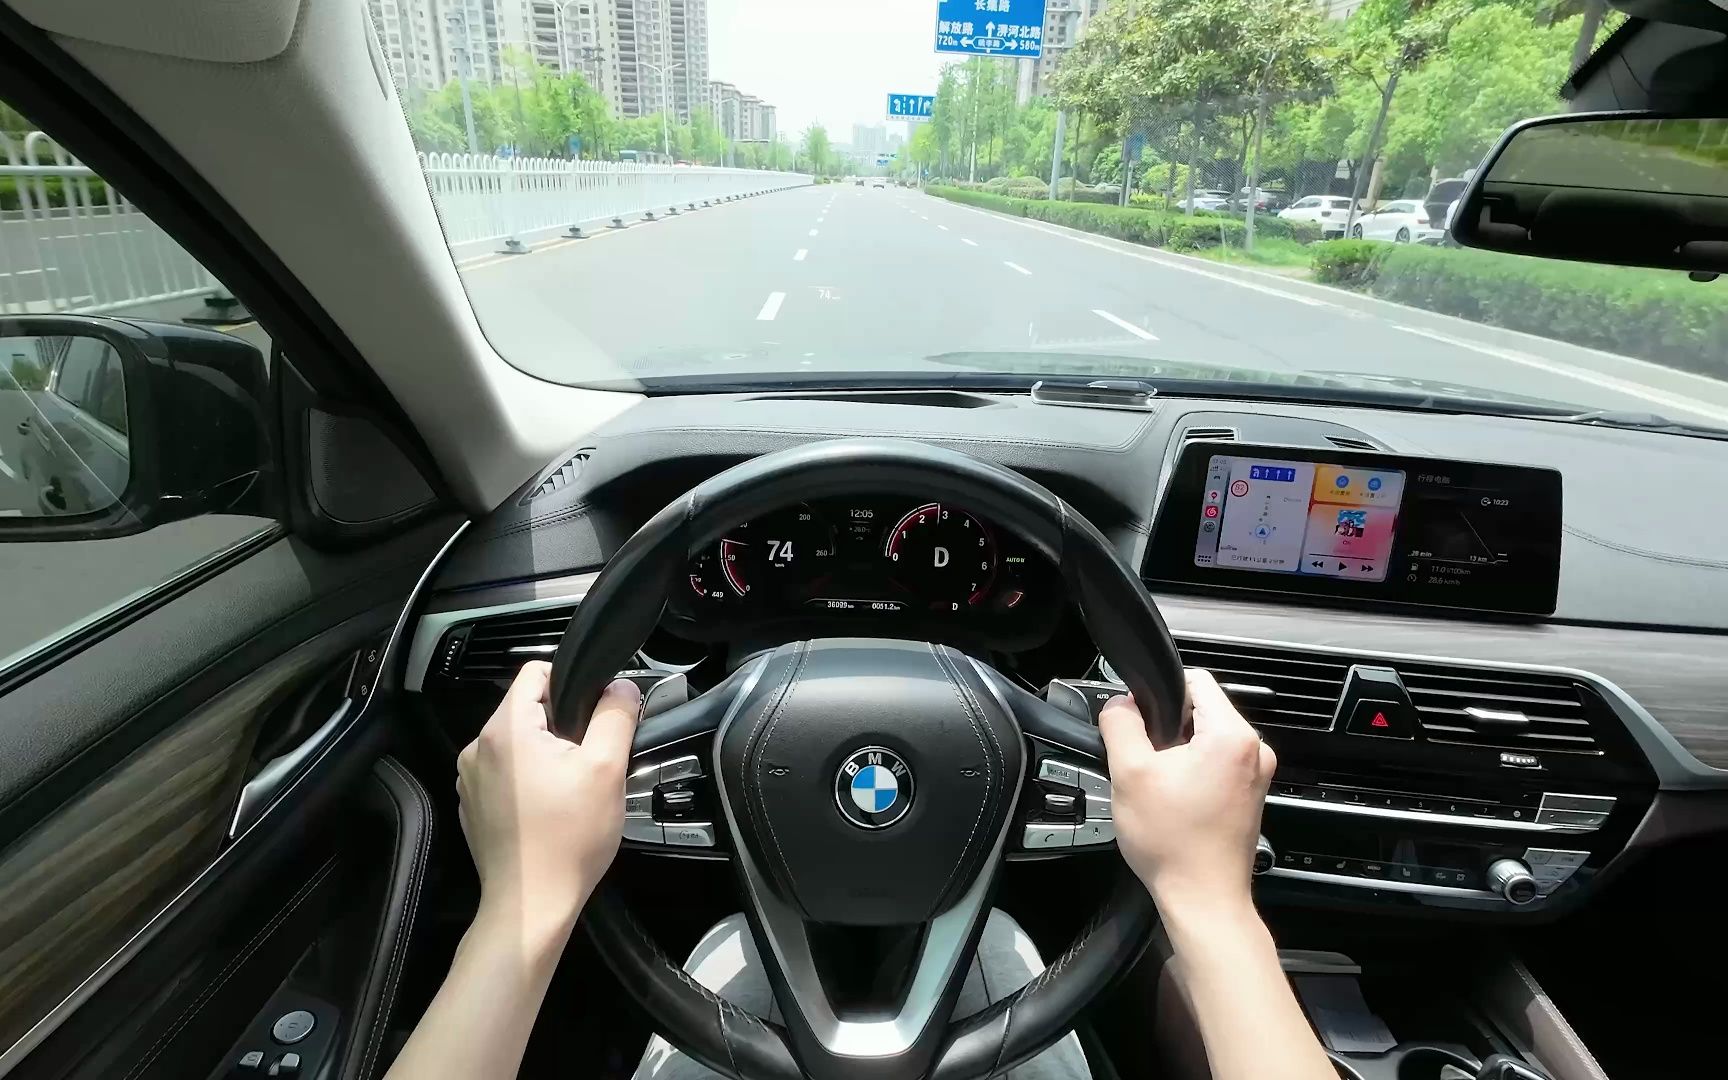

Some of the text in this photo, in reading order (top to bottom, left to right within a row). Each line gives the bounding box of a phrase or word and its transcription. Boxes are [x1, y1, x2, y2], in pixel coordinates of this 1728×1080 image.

[938, 21, 974, 36] 解放路
[938, 35, 959, 46] 720m
[1019, 40, 1040, 51] 580m
[799, 513, 811, 521] 200
[850, 509, 874, 519] 12:05
[942, 511, 949, 519] 3
[919, 515, 926, 524] 2
[964, 519, 970, 528] 4
[901, 531, 906, 539] 1
[978, 538, 985, 546] 5
[766, 540, 794, 562] 74
[892, 553, 899, 561] 0
[934, 547, 949, 568] D
[981, 562, 988, 570] 6
[971, 583, 977, 591] 7
[952, 602, 959, 610] D
[844, 752, 907, 777] BMW
